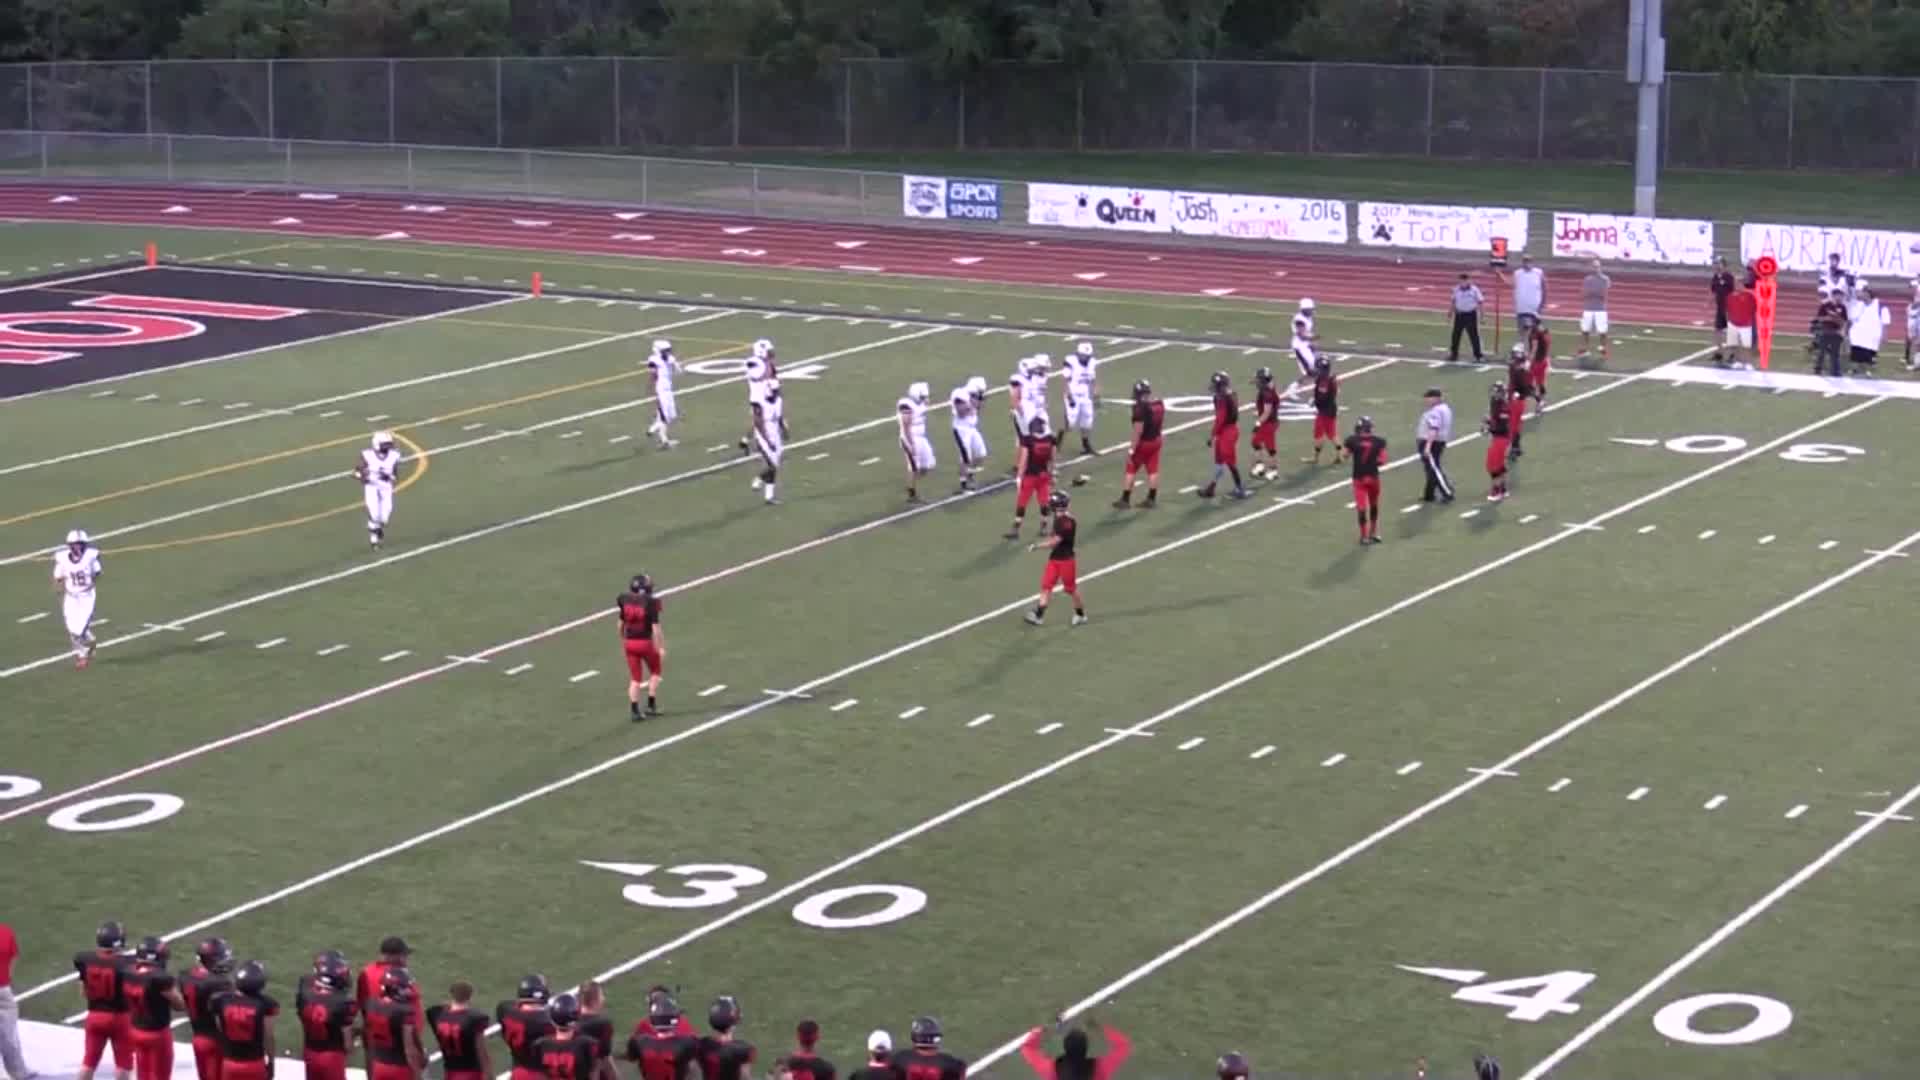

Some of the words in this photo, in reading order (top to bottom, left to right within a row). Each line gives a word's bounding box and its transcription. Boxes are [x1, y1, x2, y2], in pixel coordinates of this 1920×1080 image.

[951, 204, 998, 219] SPORTS
[1300, 200, 1342, 221] 2016
[1760, 228, 1905, 271] ADRIANNA
